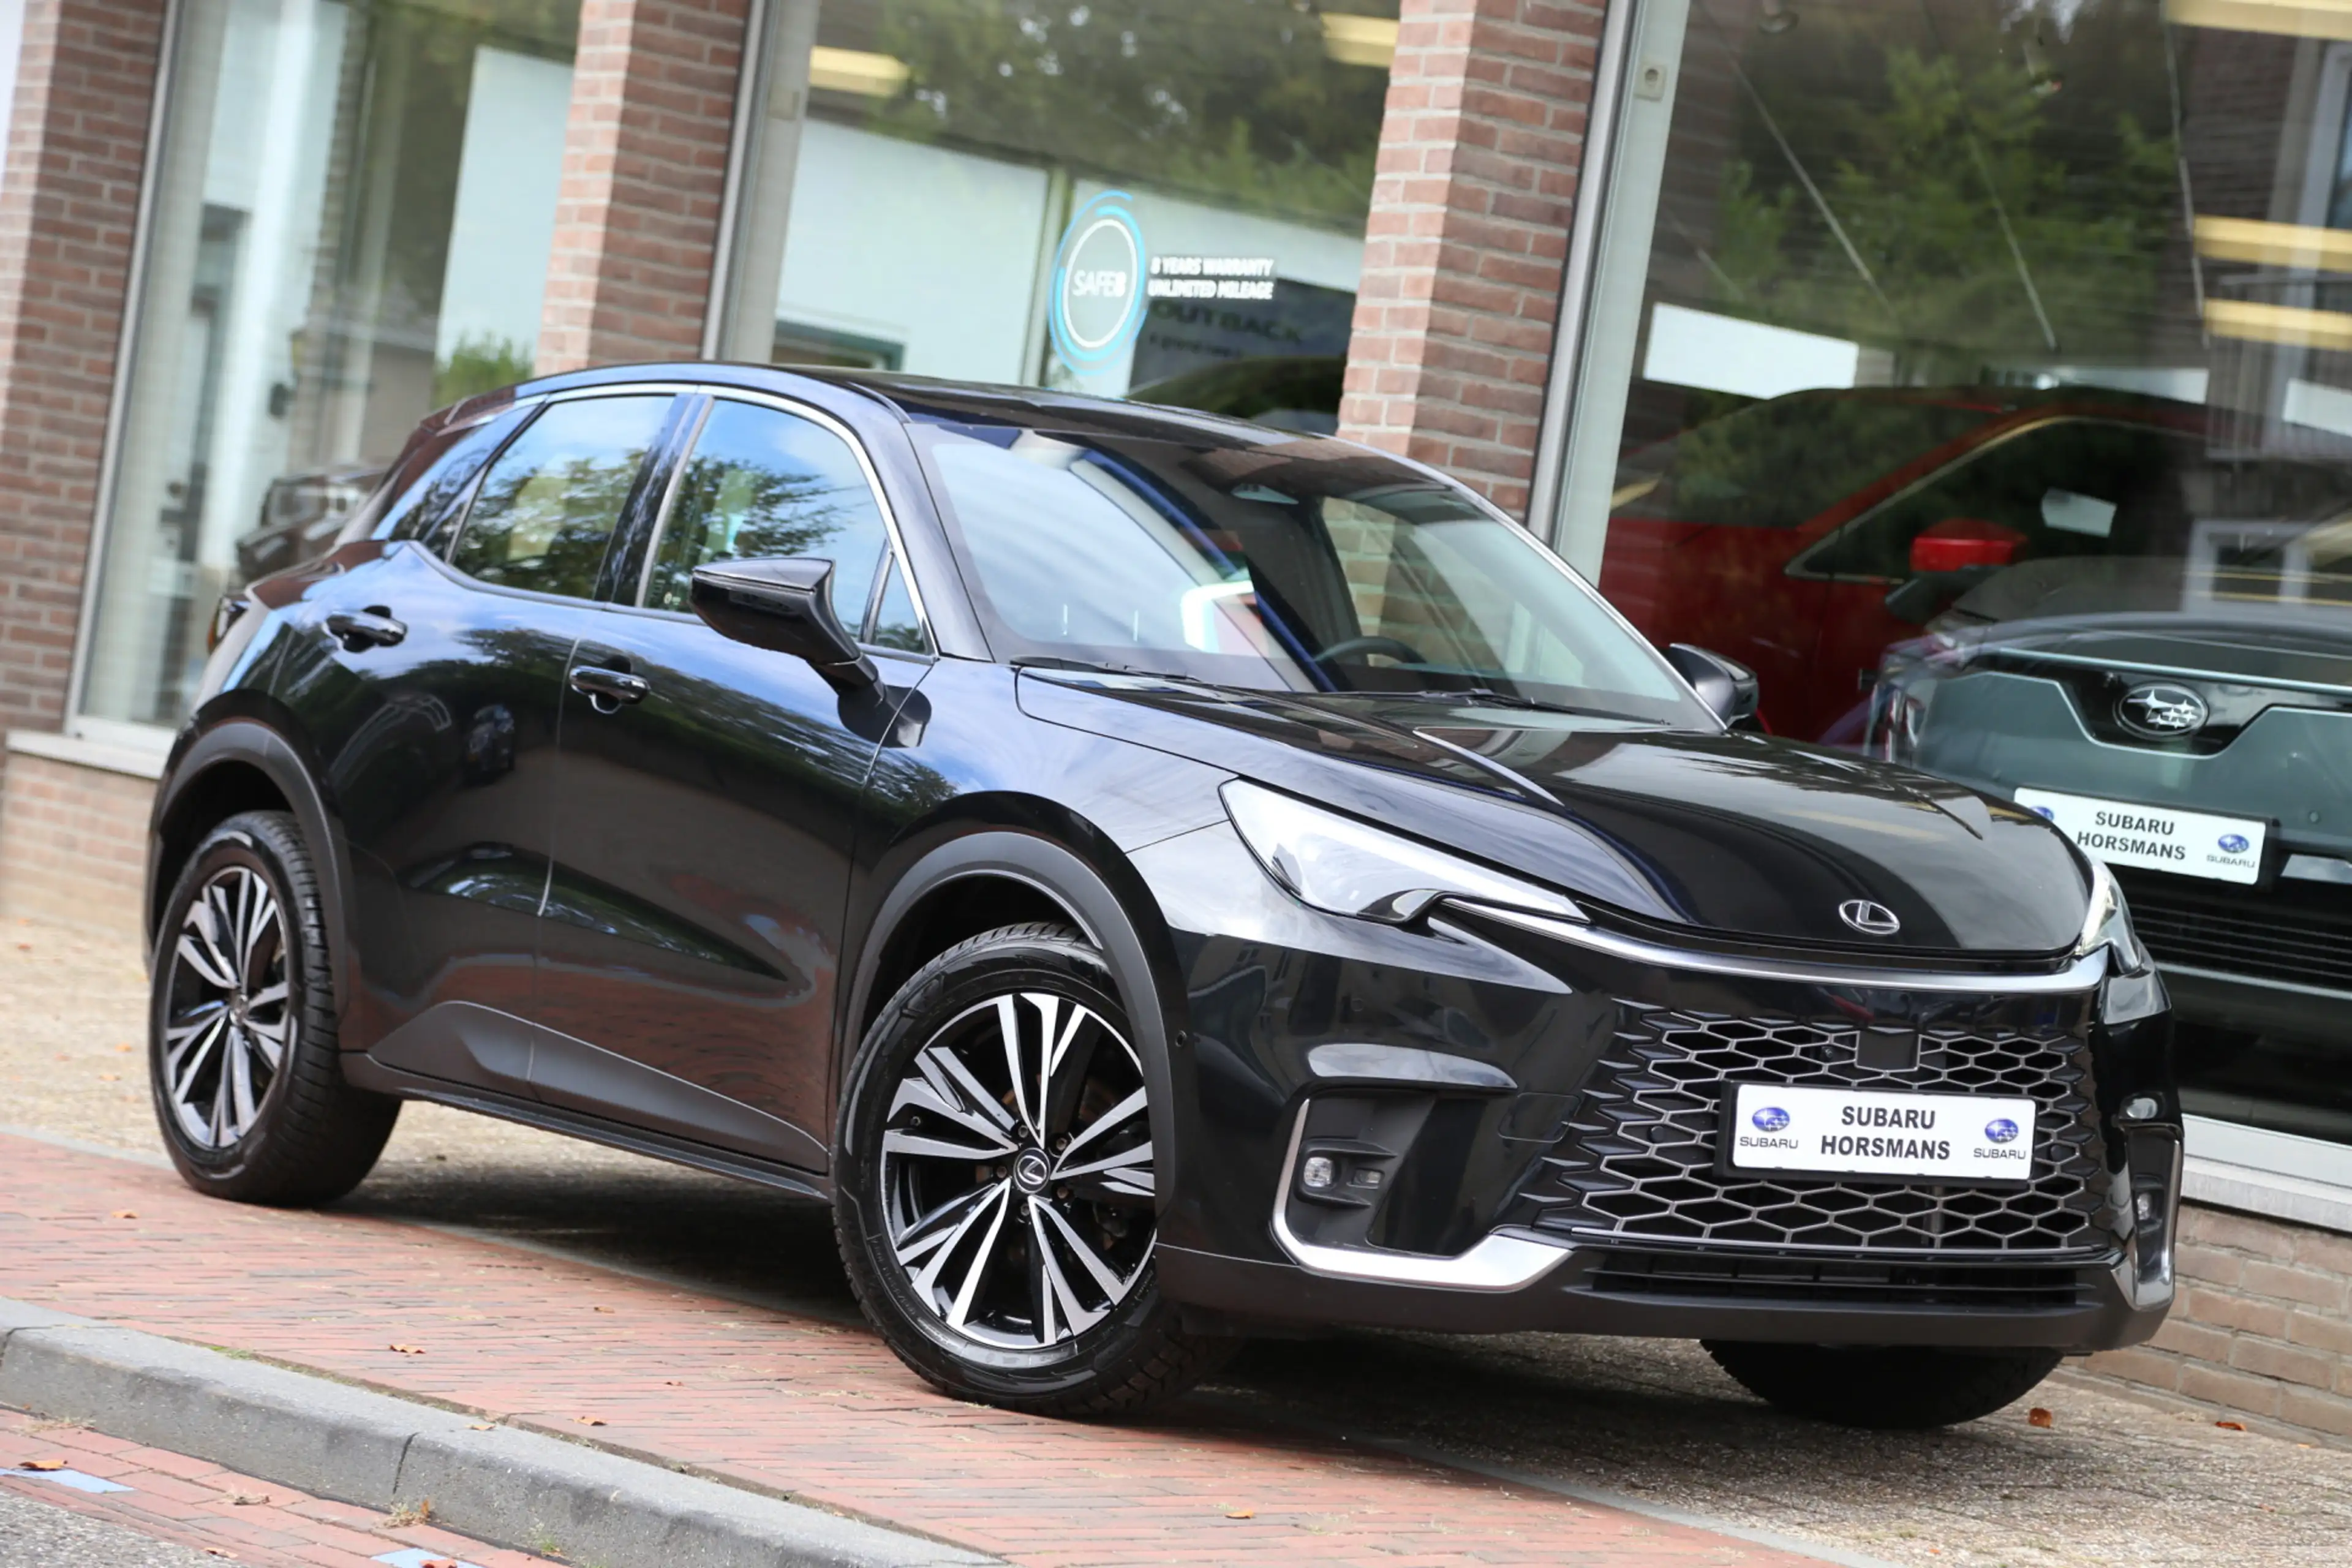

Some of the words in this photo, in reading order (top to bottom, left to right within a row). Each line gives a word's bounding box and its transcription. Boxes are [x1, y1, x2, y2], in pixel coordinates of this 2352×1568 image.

[1163, 256, 1202, 276] YEARS
[1202, 257, 1274, 277] WARRANTY
[1148, 278, 1217, 298] UNLIMITED
[1218, 280, 1274, 300] MILEAGE
[2095, 811, 2174, 835] SUBARU
[2077, 831, 2186, 860] HORSMANS
[2206, 854, 2255, 868] SUBARU
[1841, 1106, 1935, 1129] SUBARU
[1740, 1136, 1798, 1150] SUBARU
[1821, 1135, 1950, 1160] HORSMANS
[1973, 1148, 2026, 1160] SUBARU
